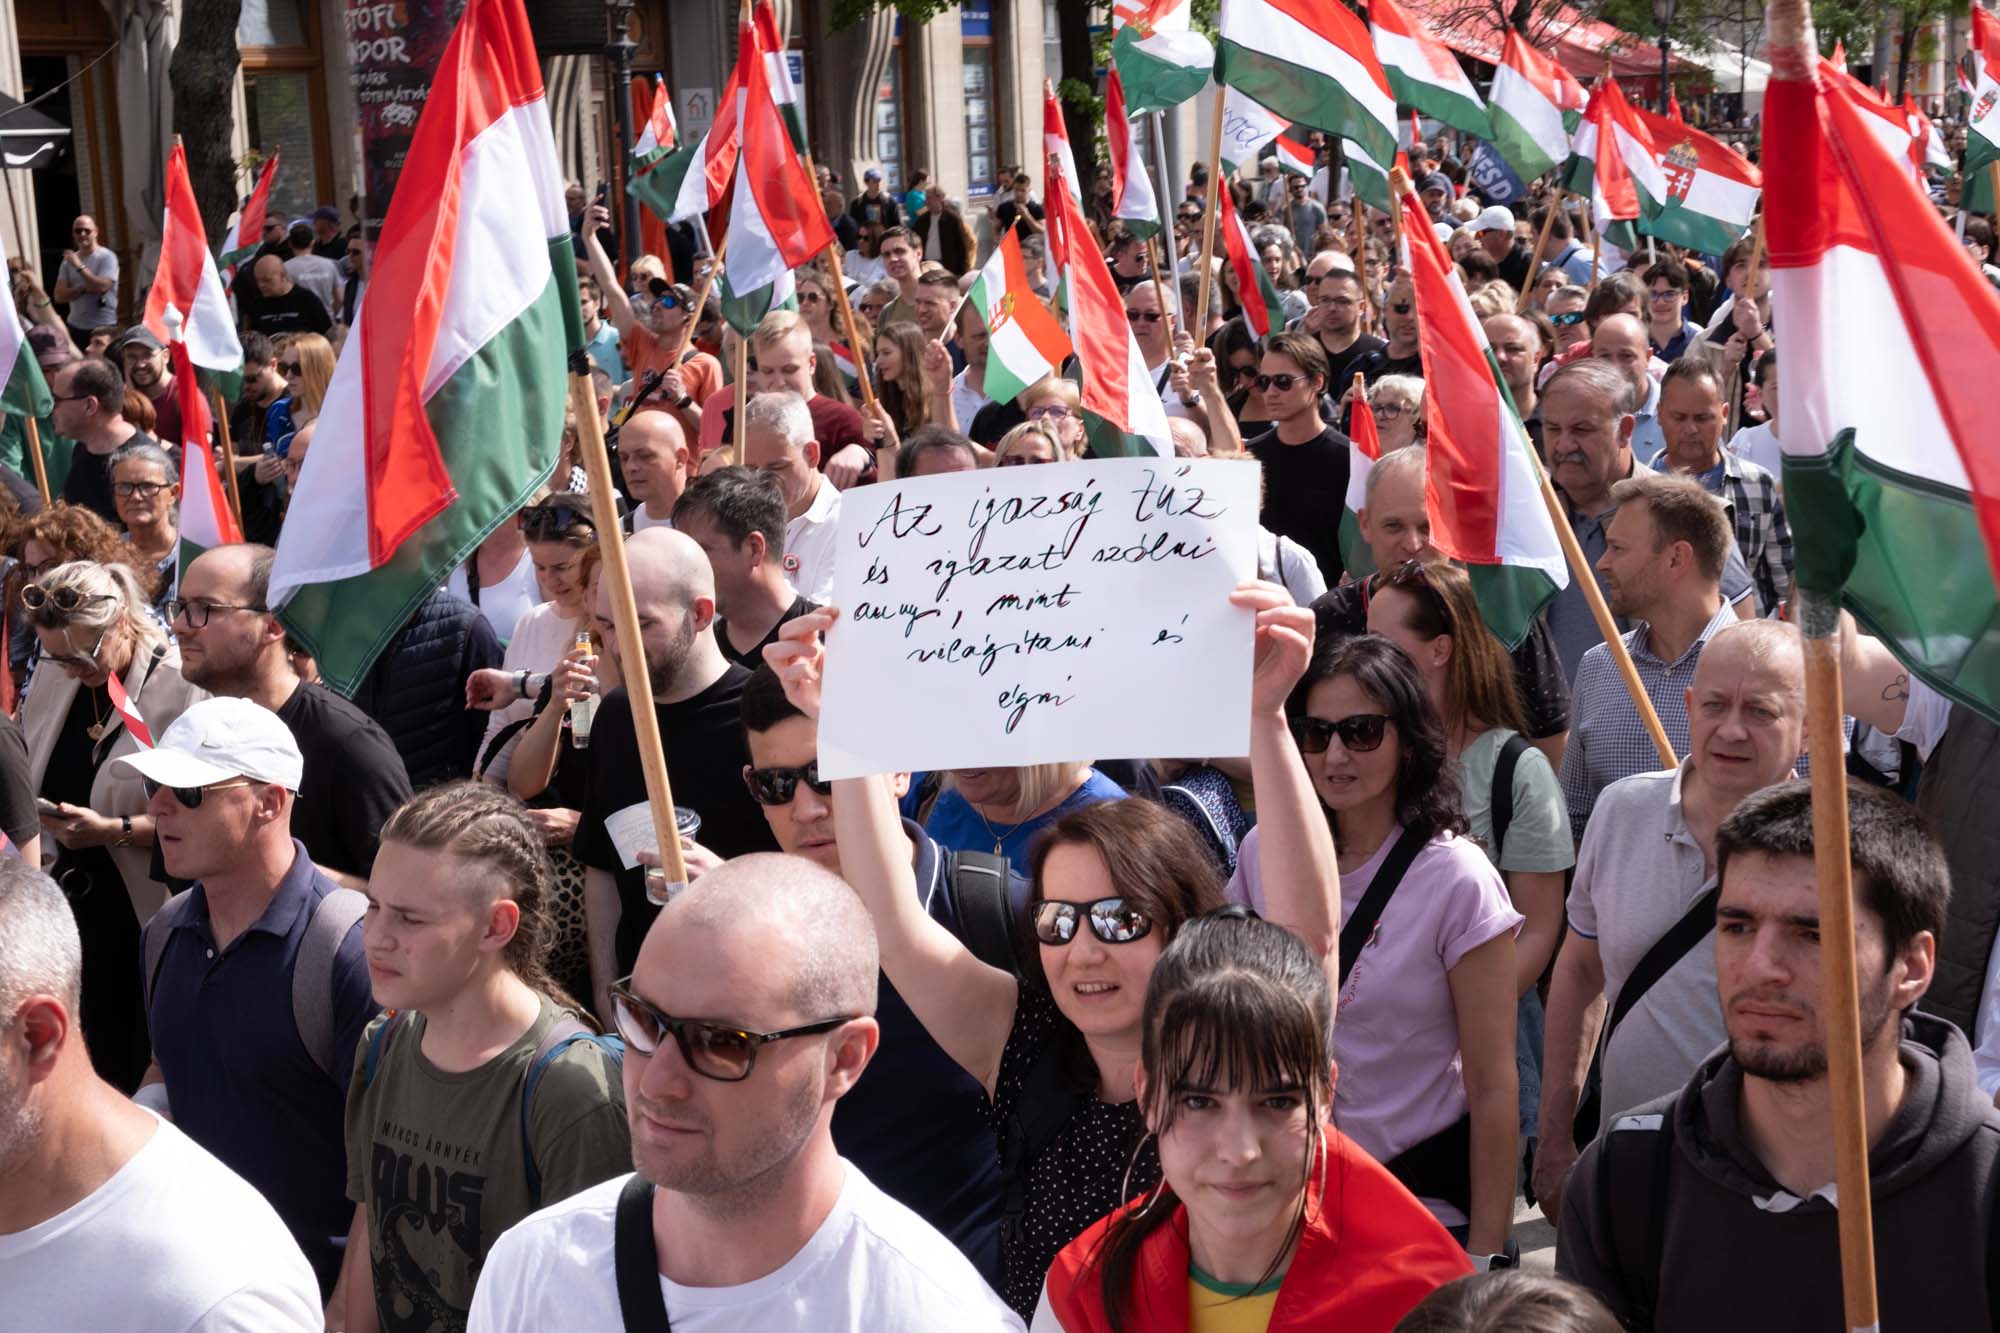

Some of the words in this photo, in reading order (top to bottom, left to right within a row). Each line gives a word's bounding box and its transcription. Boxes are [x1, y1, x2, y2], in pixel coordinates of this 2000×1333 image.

[858, 491, 942, 549] Az
[1131, 465, 1229, 523] tűz
[862, 556, 889, 585] és
[925, 551, 1065, 603] igazat
[1091, 531, 1218, 563] szólni
[985, 583, 1083, 616] mint
[381, 1119, 419, 1147] NINCS
[425, 1132, 481, 1167] ÁRNYÉK
